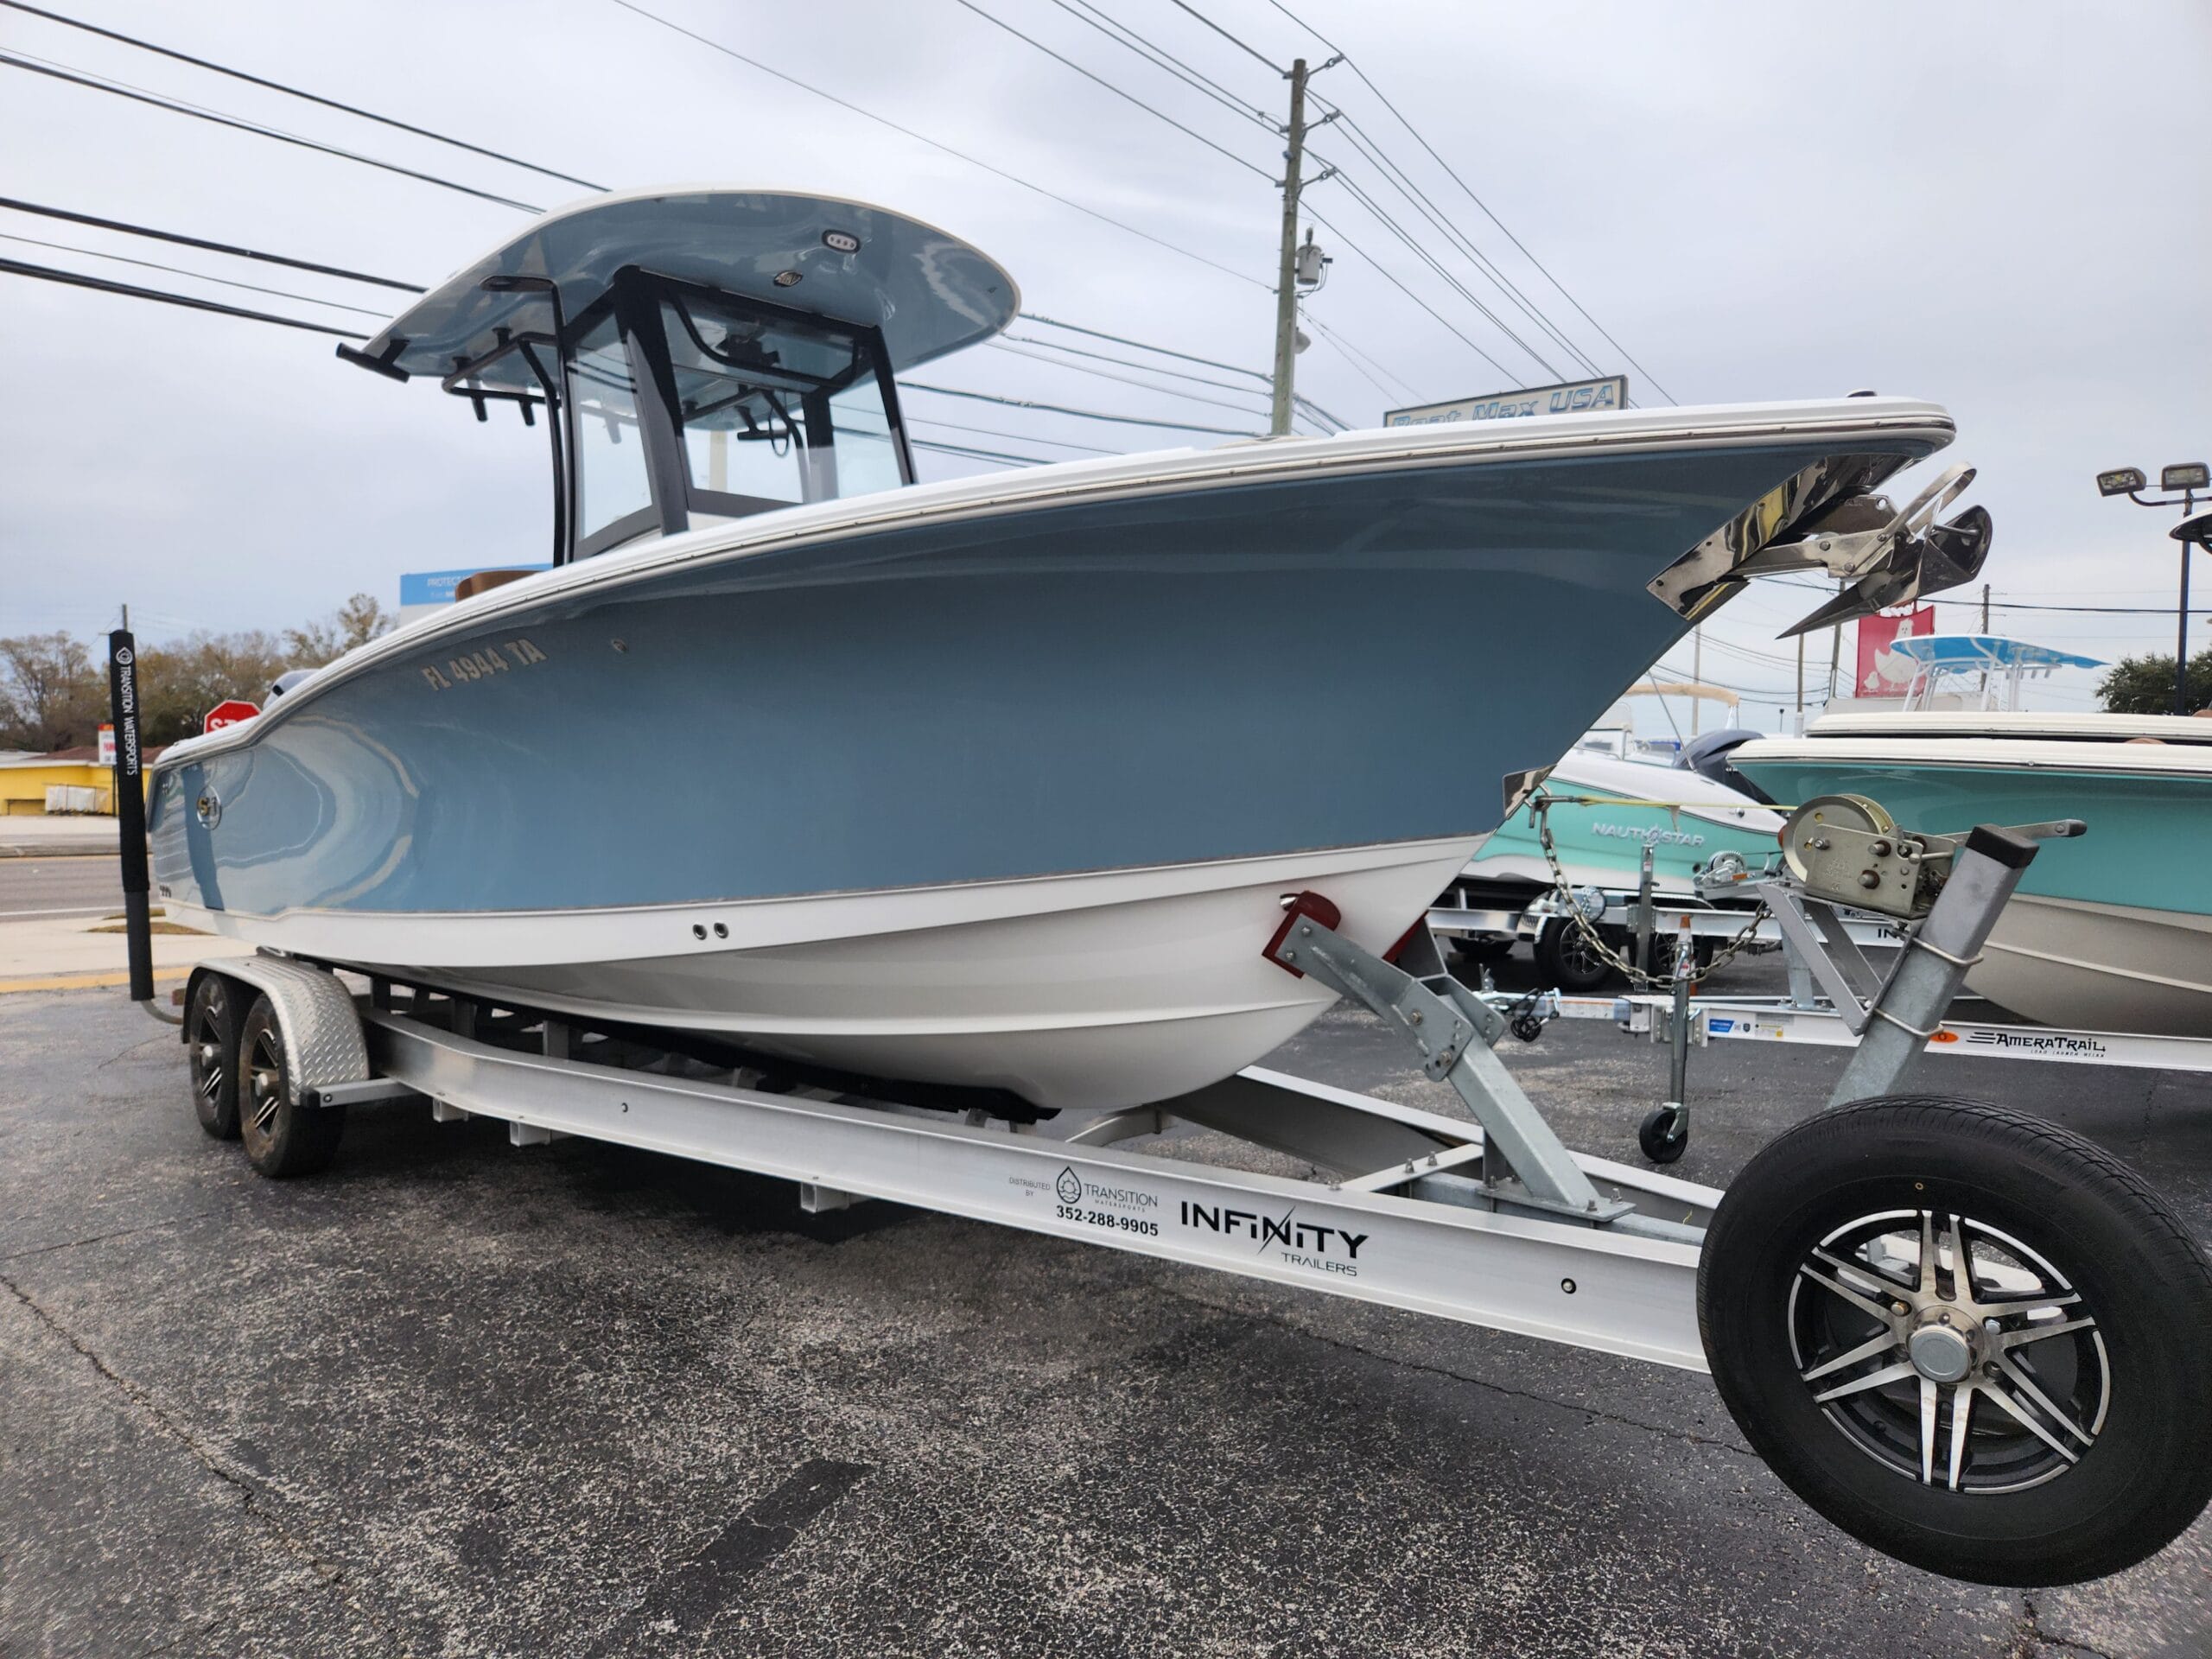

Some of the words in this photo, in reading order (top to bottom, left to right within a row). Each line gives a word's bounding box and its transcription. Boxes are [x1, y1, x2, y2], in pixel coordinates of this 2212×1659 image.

[1472, 401, 1538, 421] Max
[1548, 385, 1615, 413] USA
[422, 665, 452, 690] FL
[448, 648, 509, 683] 4944
[505, 639, 548, 665] TA
[120, 665, 134, 714] TRANSITION
[124, 715, 138, 776] WATERSPORTS
[1008, 1177, 1051, 1191] DISTRIBUTED
[1084, 1183, 1158, 1208] TRANSITION
[1056, 1205, 1159, 1236] 352-288-9905
[1095, 1199, 1146, 1213] WATERSPORTS
[1281, 1252, 1357, 1277] TRAILERS
